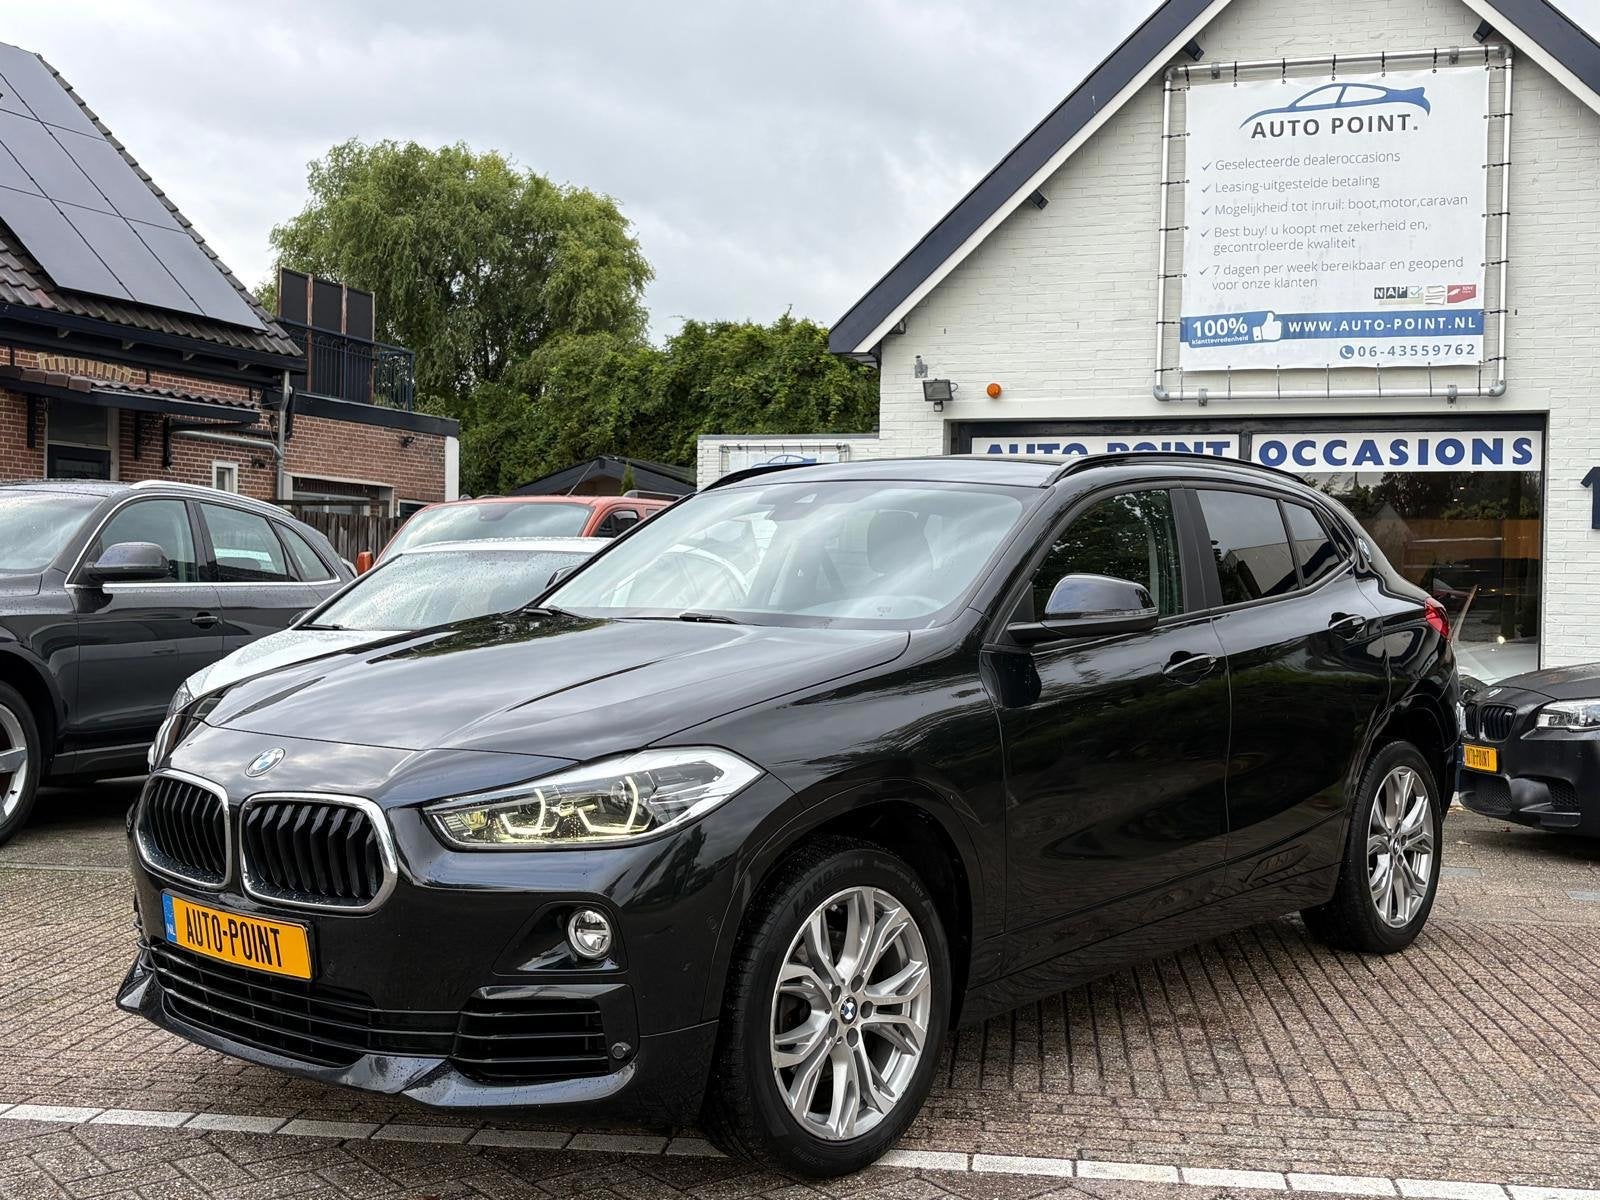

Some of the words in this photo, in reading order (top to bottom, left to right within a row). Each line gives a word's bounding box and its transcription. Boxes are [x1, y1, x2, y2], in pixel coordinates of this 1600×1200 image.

[1251, 118, 1320, 139] AUTO
[1215, 156, 1300, 170] Geselecteerde
[1303, 151, 1400, 166] dealeroccasions
[1215, 178, 1328, 193] Leasing-uitgestelde
[1332, 176, 1380, 188] betaling
[1215, 201, 1288, 217] Mogelijkheid
[1291, 203, 1308, 212] tot
[1311, 199, 1345, 211] inruil:
[1214, 227, 1240, 238] Best
[1243, 226, 1268, 239] buy!
[1271, 227, 1279, 236] u
[1282, 224, 1316, 236] koopt
[1320, 223, 1343, 233] met
[1347, 219, 1406, 232] zekerheid
[1409, 221, 1428, 231] en,
[1213, 239, 1304, 256] gecontroleerde
[1307, 237, 1355, 249] kwaliteit
[1213, 265, 1220, 275] 7
[1223, 264, 1260, 277] dagen
[1263, 264, 1283, 276] per
[1286, 261, 1318, 273] week
[1321, 259, 1386, 272] bereikbaar
[1389, 261, 1405, 270] en
[1408, 257, 1464, 272] geopend
[1212, 281, 1239, 290] voor
[1241, 280, 1270, 289] onze
[1274, 277, 1318, 288] klanten
[1374, 286, 1408, 299] NAP
[1192, 316, 1248, 338] 100%
[1288, 316, 1477, 332] WWW.AUTO-POINT.NL
[1357, 344, 1476, 358] 06-43559762
[1258, 438, 1533, 467] OCCASIONS
[186, 907, 282, 967] AUTO-POINT
